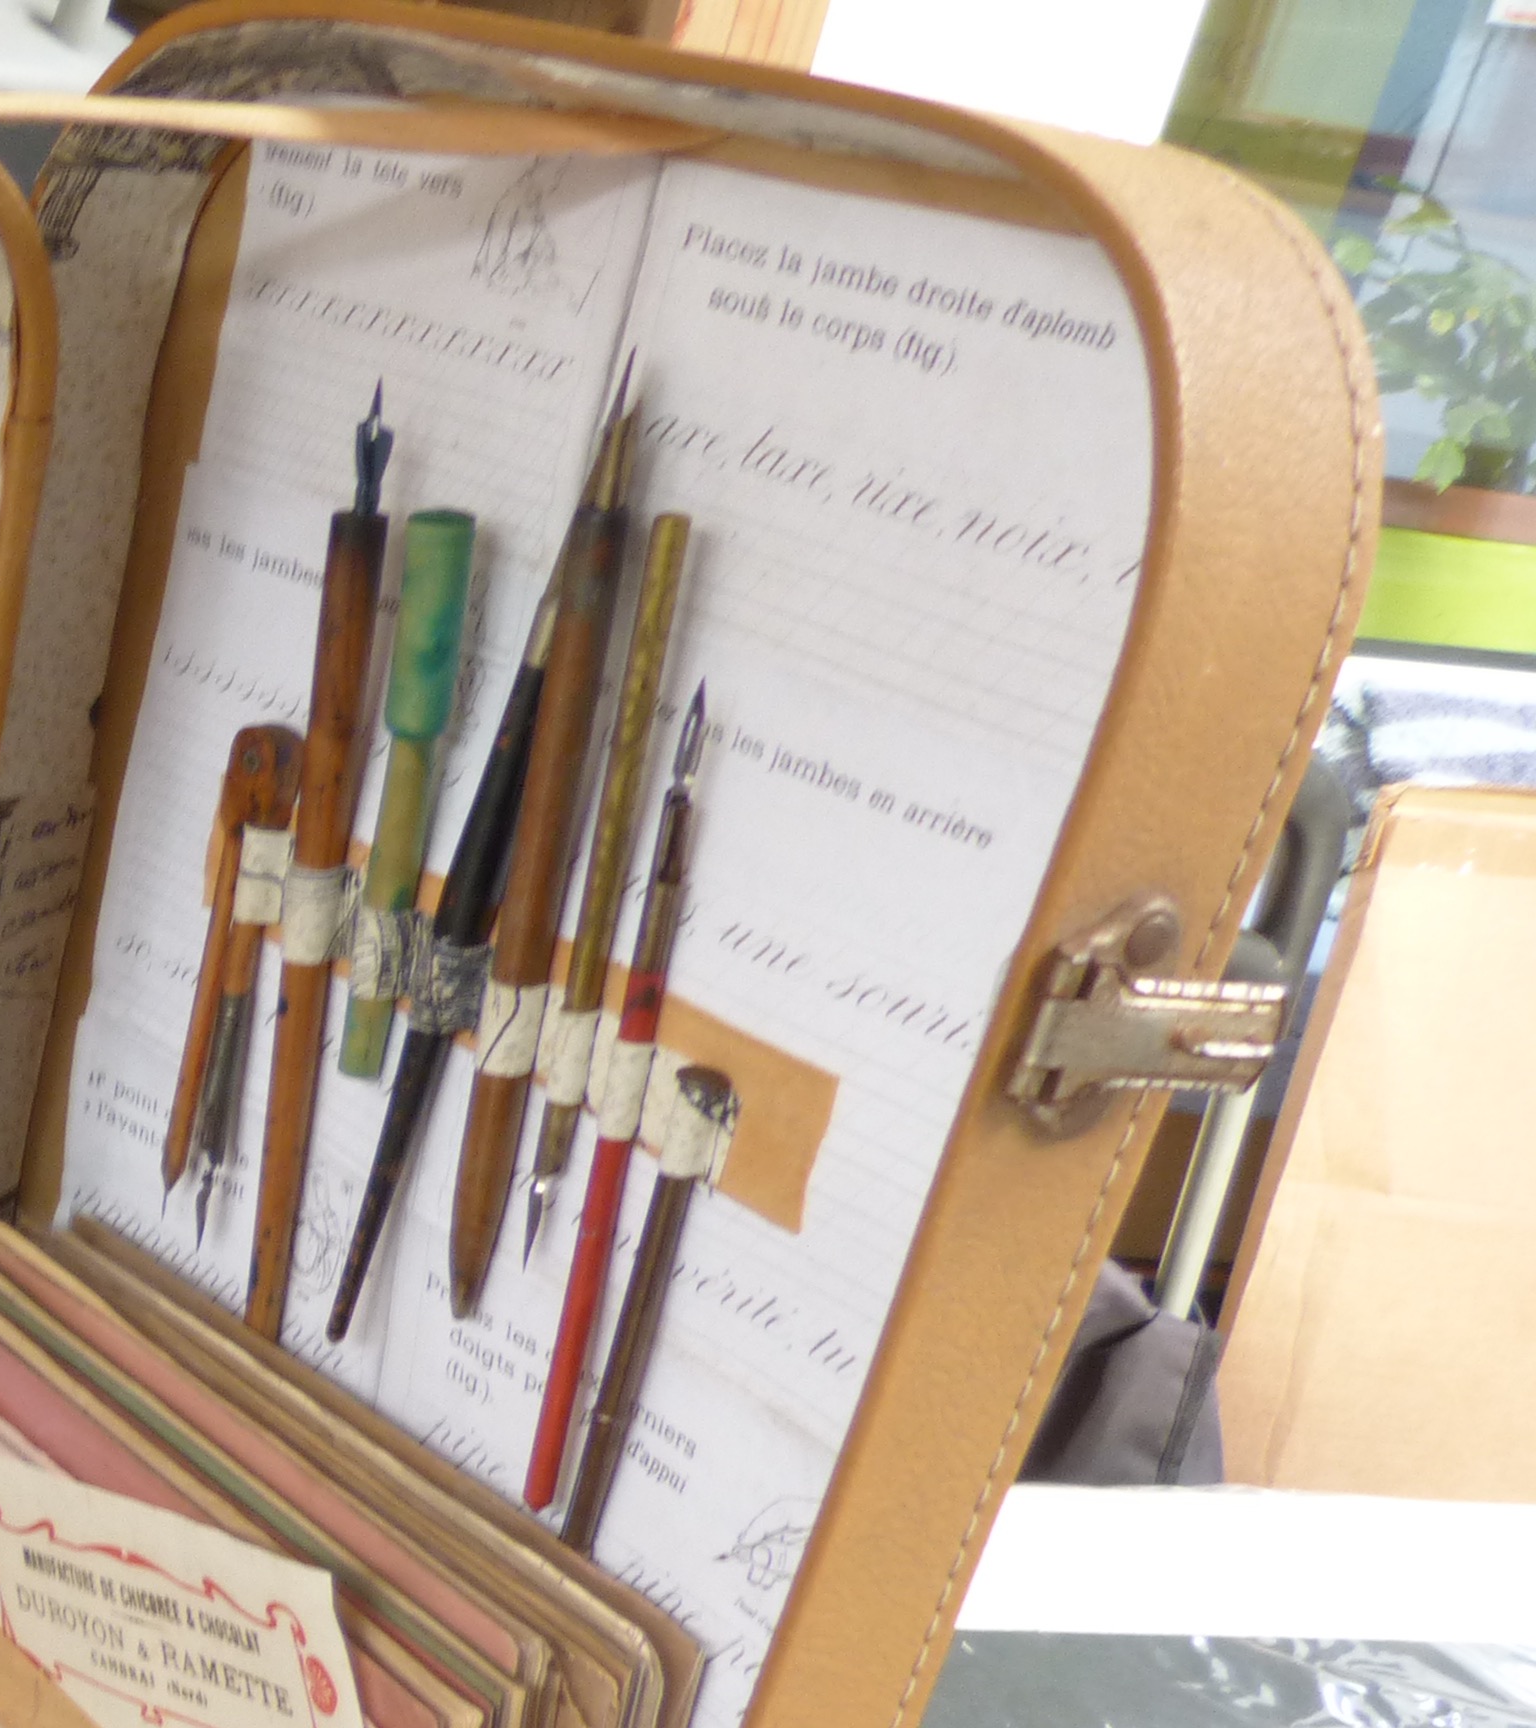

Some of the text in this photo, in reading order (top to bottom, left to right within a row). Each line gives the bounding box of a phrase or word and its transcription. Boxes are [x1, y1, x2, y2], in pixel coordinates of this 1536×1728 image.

[683, 223, 1118, 352] Placez la jambe droite d'aplomb
[708, 286, 772, 322] sous
[778, 298, 804, 330] le
[811, 312, 885, 355] corps
[730, 725, 766, 762] les
[768, 745, 862, 802] jambes
[868, 786, 896, 816] en
[903, 797, 995, 851] arrière
[448, 1325, 516, 1380] doigts
[504, 1319, 537, 1356] les
[627, 1437, 689, 1495] d'appui
[22, 1545, 97, 1596] MANUFACTURE
[99, 1575, 116, 1601] DE
[186, 1606, 197, 1630] &
[198, 1610, 262, 1657] CHOCOLAT
[16, 1582, 294, 1718] DUROYON & RAMETTE
[90, 1649, 156, 1689] CAMBRAI
